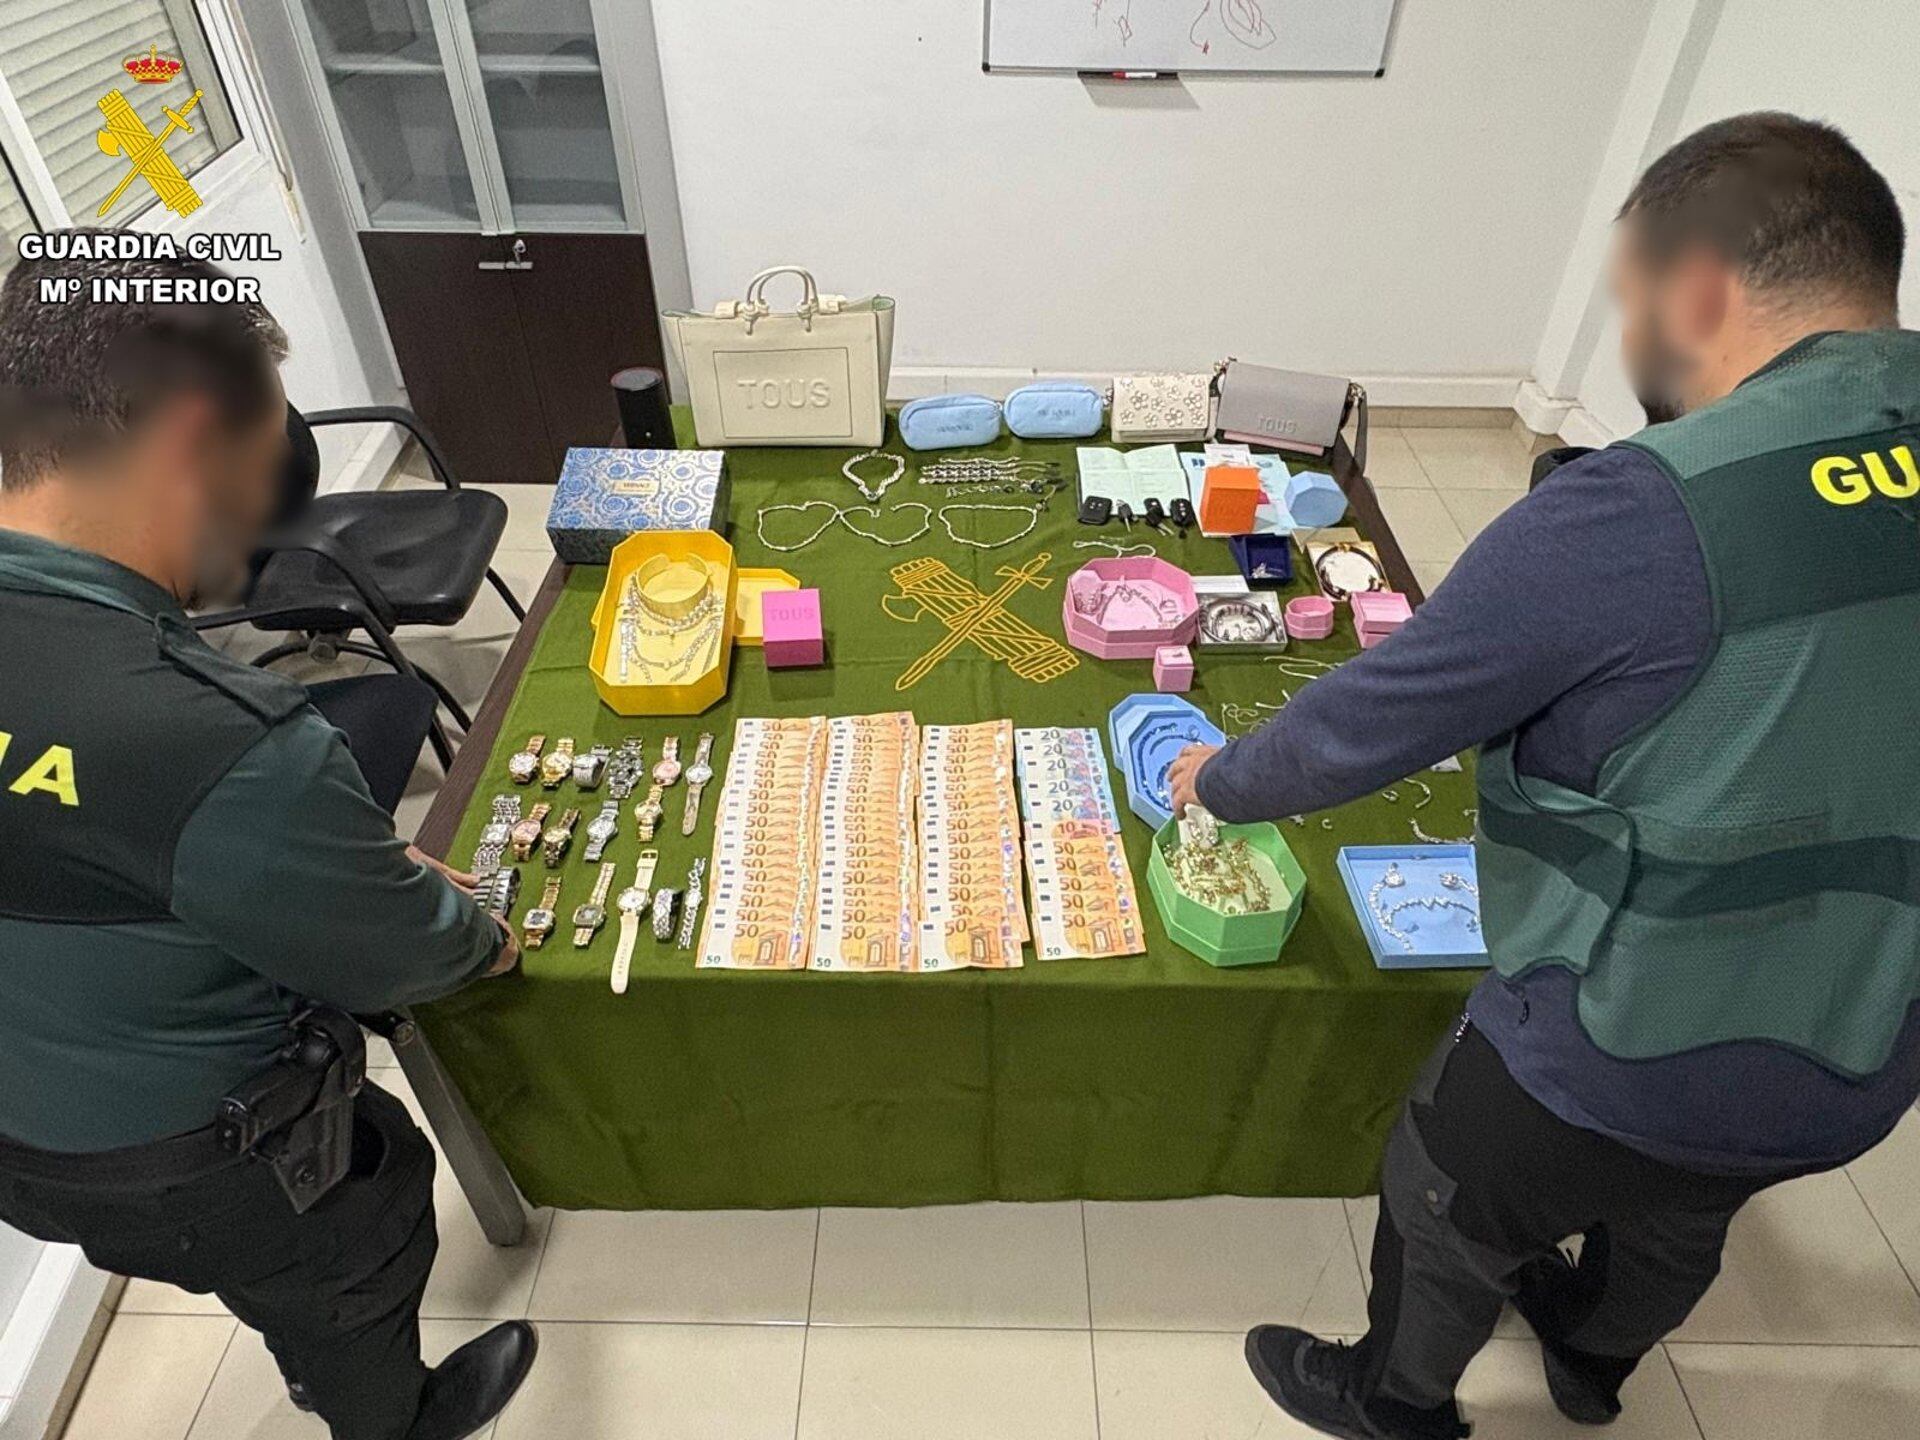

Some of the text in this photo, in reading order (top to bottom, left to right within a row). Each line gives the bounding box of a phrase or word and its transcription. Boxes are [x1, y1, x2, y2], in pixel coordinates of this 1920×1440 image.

[737, 379, 831, 410] TOUS
[1811, 445, 1920, 505] GU
[769, 606, 814, 621] TOUS
[762, 721, 781, 731] 50
[1040, 729, 1060, 740] 20
[1044, 743, 1062, 756] 20
[1047, 758, 1067, 771] 20
[1049, 780, 1070, 794] 20
[748, 789, 769, 800] 50
[747, 802, 769, 814] 50
[947, 800, 969, 811] 50
[1052, 799, 1074, 812] 20
[745, 816, 768, 828] 50
[946, 818, 968, 831] 50
[1057, 821, 1076, 834] 10
[743, 830, 766, 841] 50
[845, 832, 866, 844] 50
[948, 832, 970, 845] 50
[744, 843, 767, 856] 50
[845, 846, 867, 858] 50
[949, 847, 971, 860] 50
[1053, 840, 1074, 855] 50
[1055, 856, 1077, 871] 50
[744, 870, 767, 882] 50
[843, 871, 865, 884] 50
[949, 872, 971, 885] 50
[1059, 877, 1081, 891] 50
[739, 895, 763, 907] 50
[948, 887, 971, 902] 50
[1061, 893, 1084, 909] 50
[737, 910, 759, 921] 50
[842, 909, 866, 923] 50
[1062, 913, 1086, 928] 50
[734, 923, 759, 938] 50
[842, 925, 866, 940] 50
[944, 918, 967, 937] 50
[1046, 946, 1061, 956] 50
[706, 955, 720, 964] 50
[816, 957, 831, 967] 50
[924, 958, 938, 968] 50
